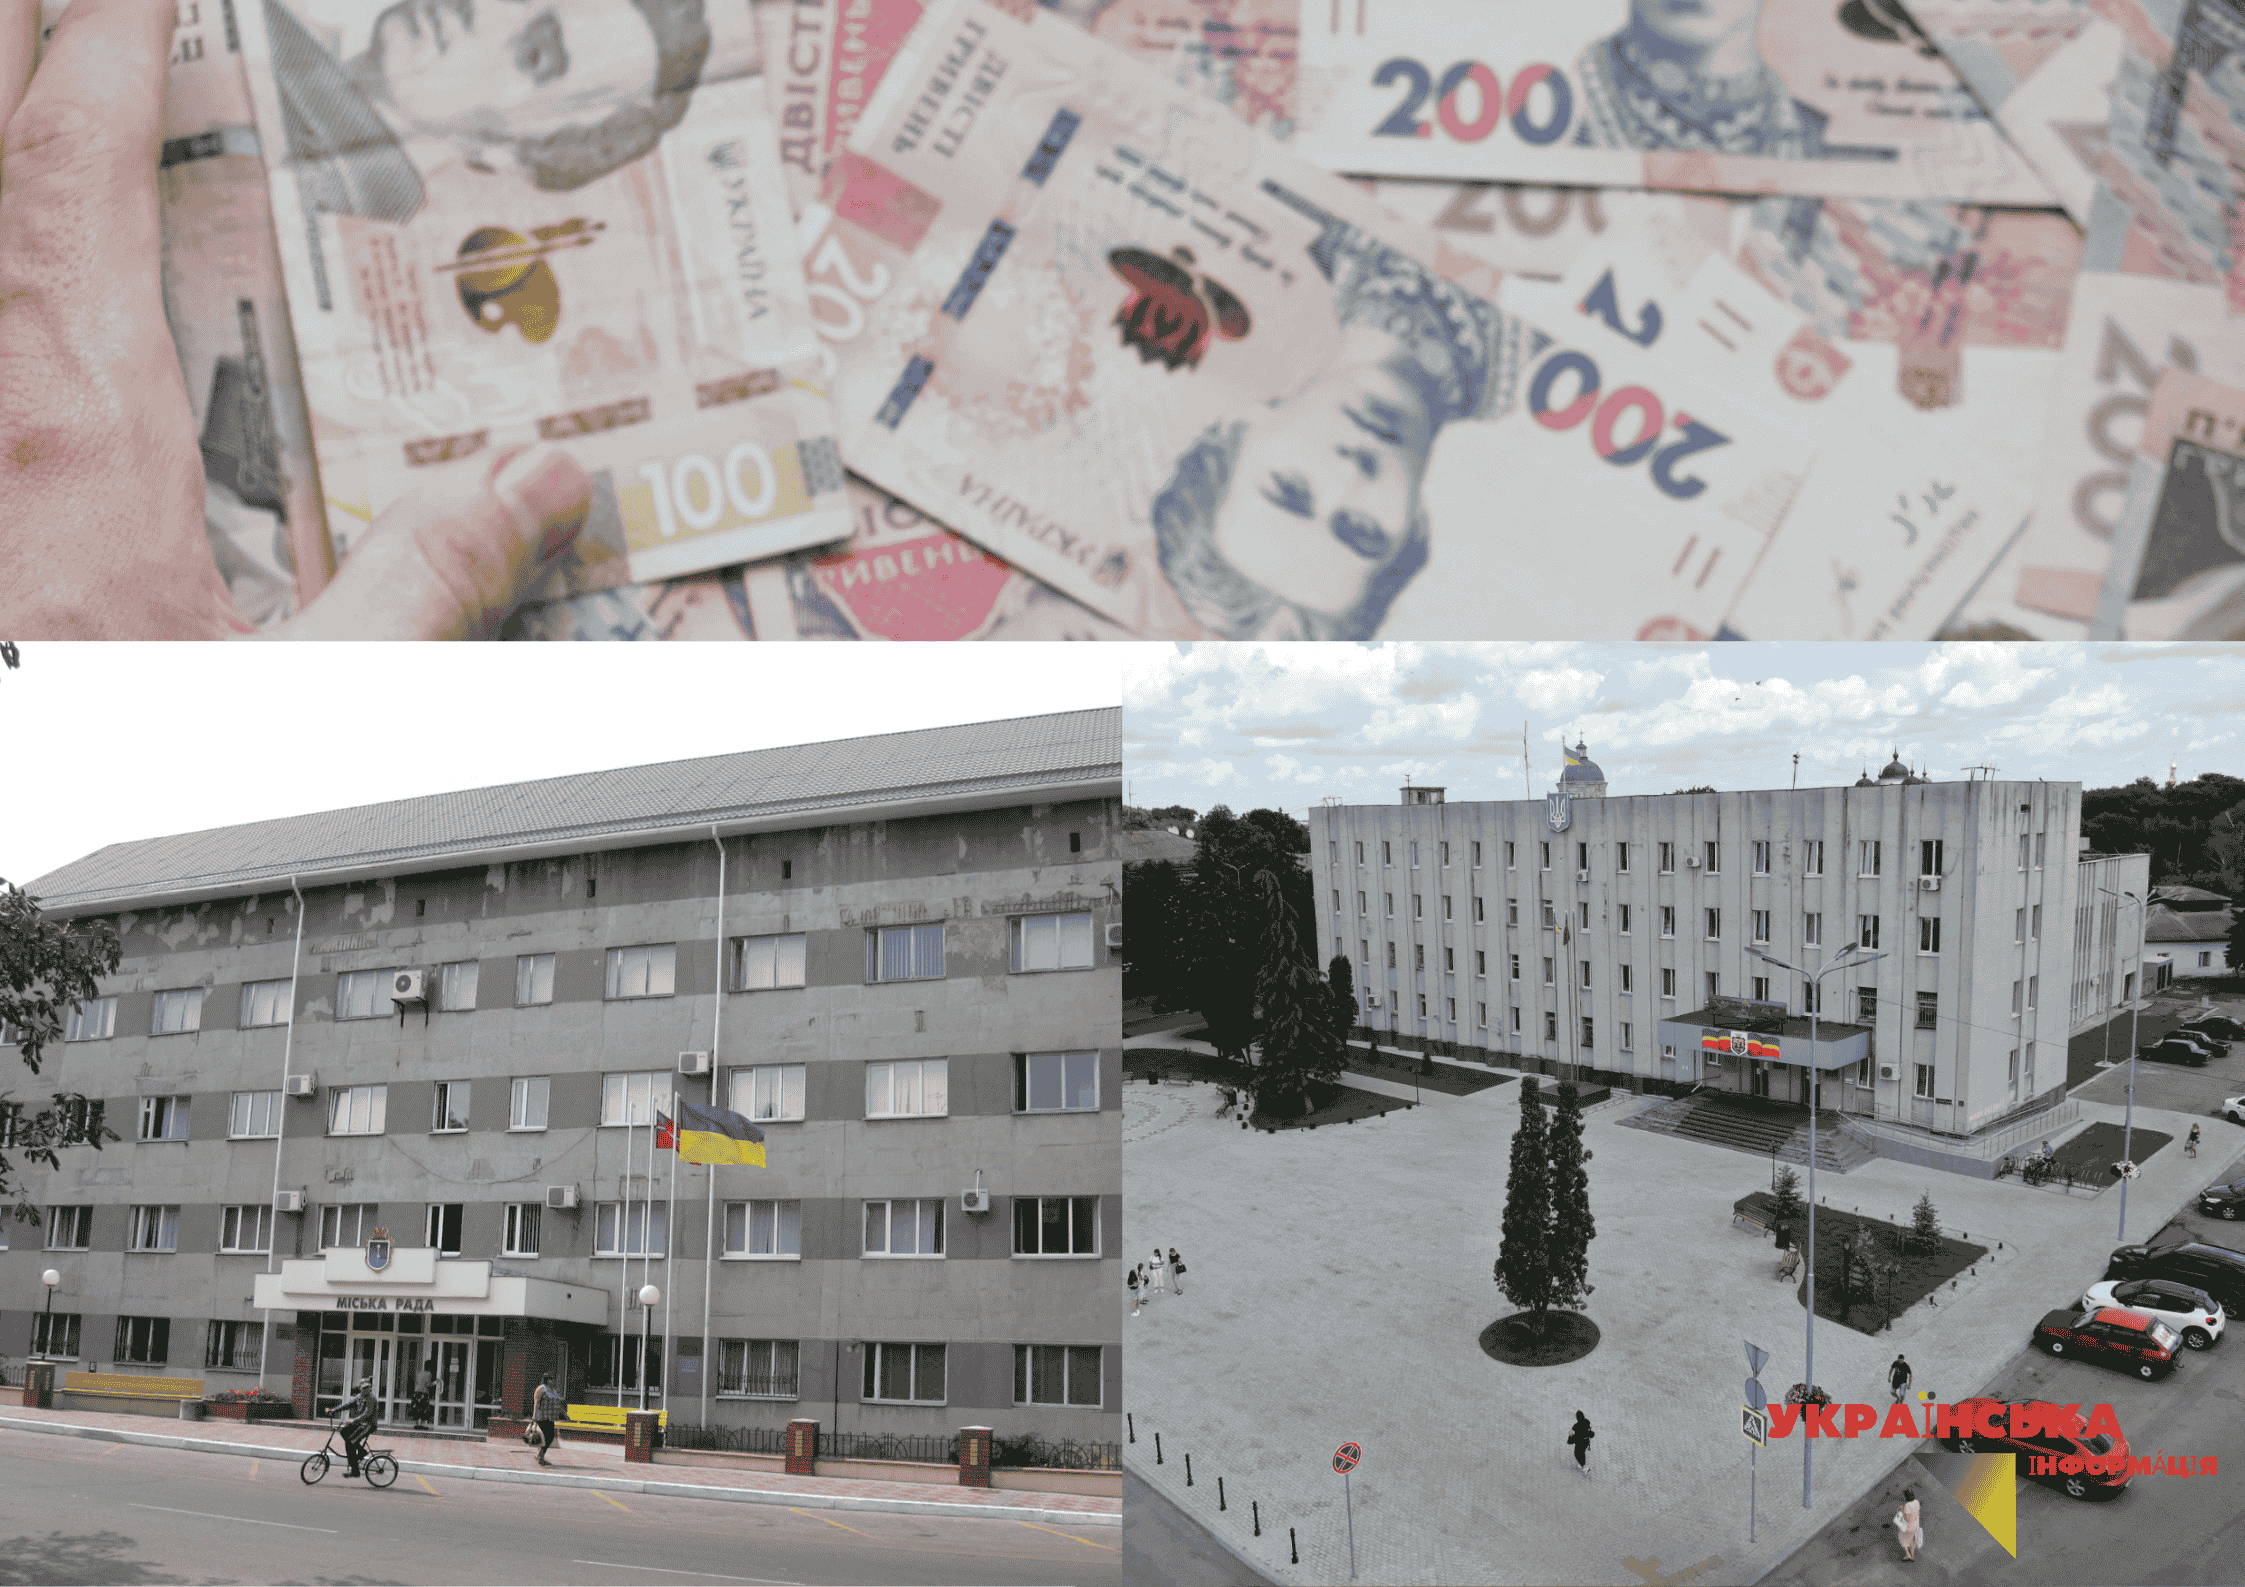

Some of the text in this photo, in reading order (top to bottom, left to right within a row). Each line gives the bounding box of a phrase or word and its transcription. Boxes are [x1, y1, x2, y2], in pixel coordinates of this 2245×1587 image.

[892, 18, 987, 153] ГРИВЕНЬ
[1369, 57, 1574, 147] 200
[1527, 350, 1734, 500] 200
[637, 442, 777, 540] 100
[336, 1297, 434, 1312] МІСЬКА РАДА
